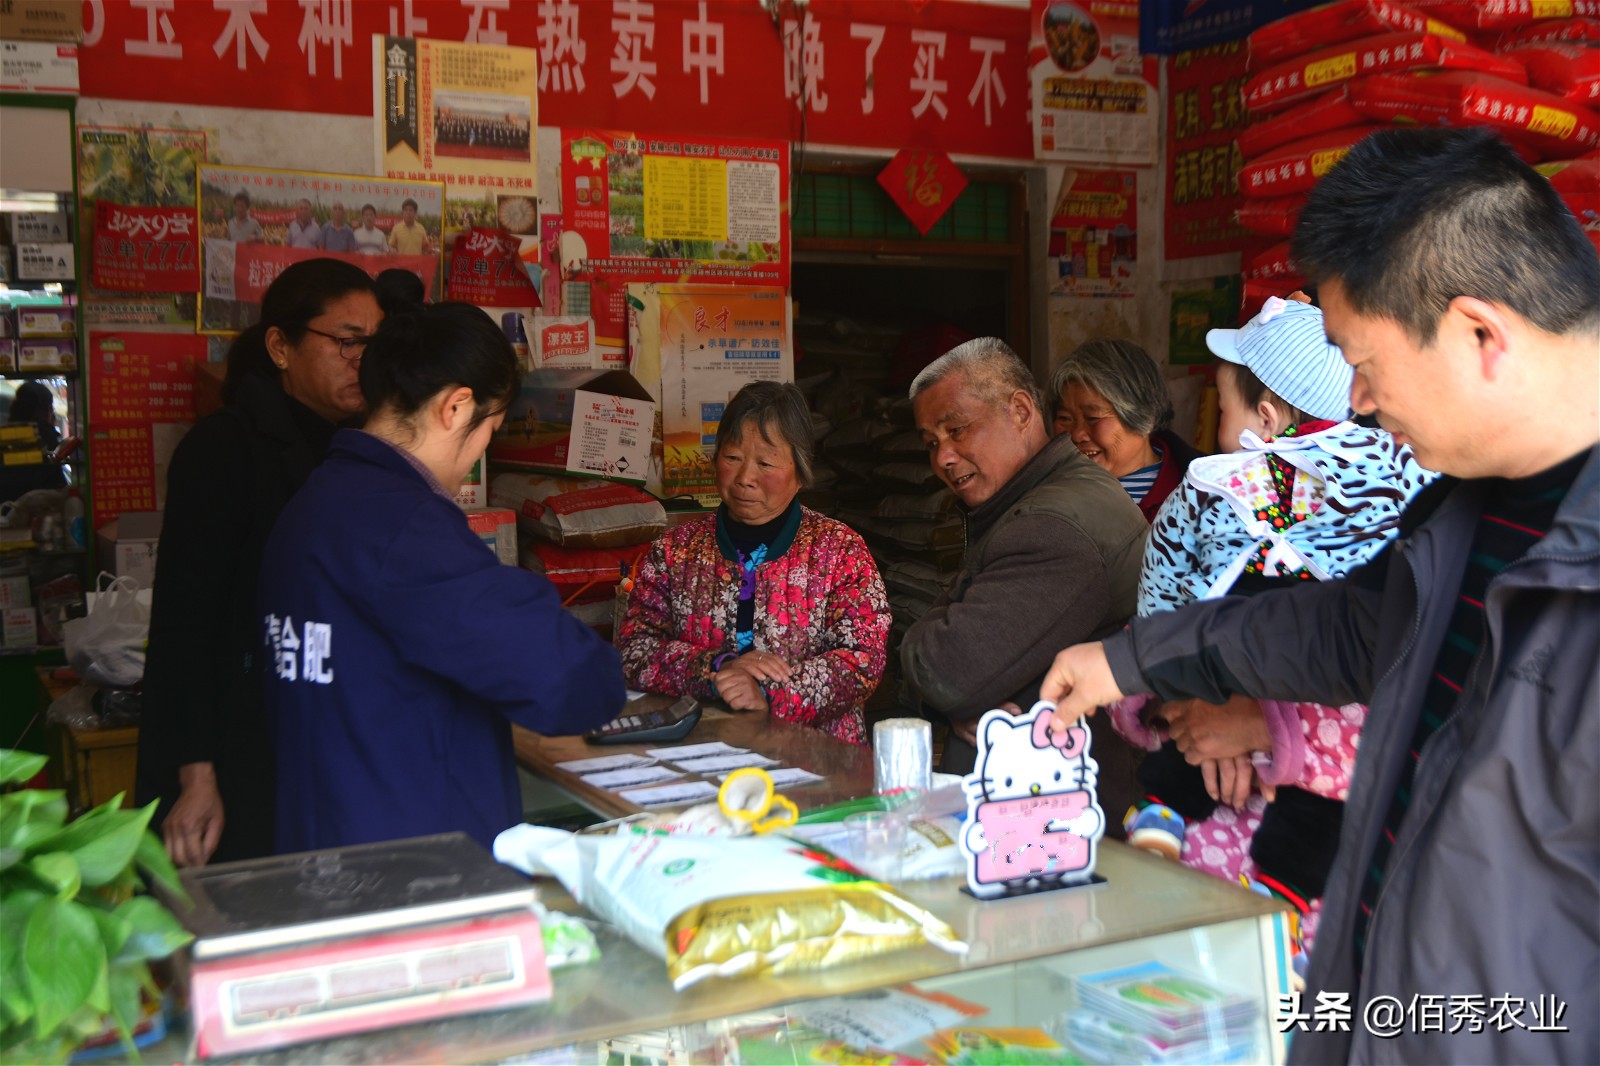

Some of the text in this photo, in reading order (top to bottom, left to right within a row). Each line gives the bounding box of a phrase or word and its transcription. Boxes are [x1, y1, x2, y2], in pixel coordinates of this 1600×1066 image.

[783, 11, 1034, 127] 晚了买不
[613, 138, 646, 151] 亿万市场
[695, 306, 730, 333] 良才
